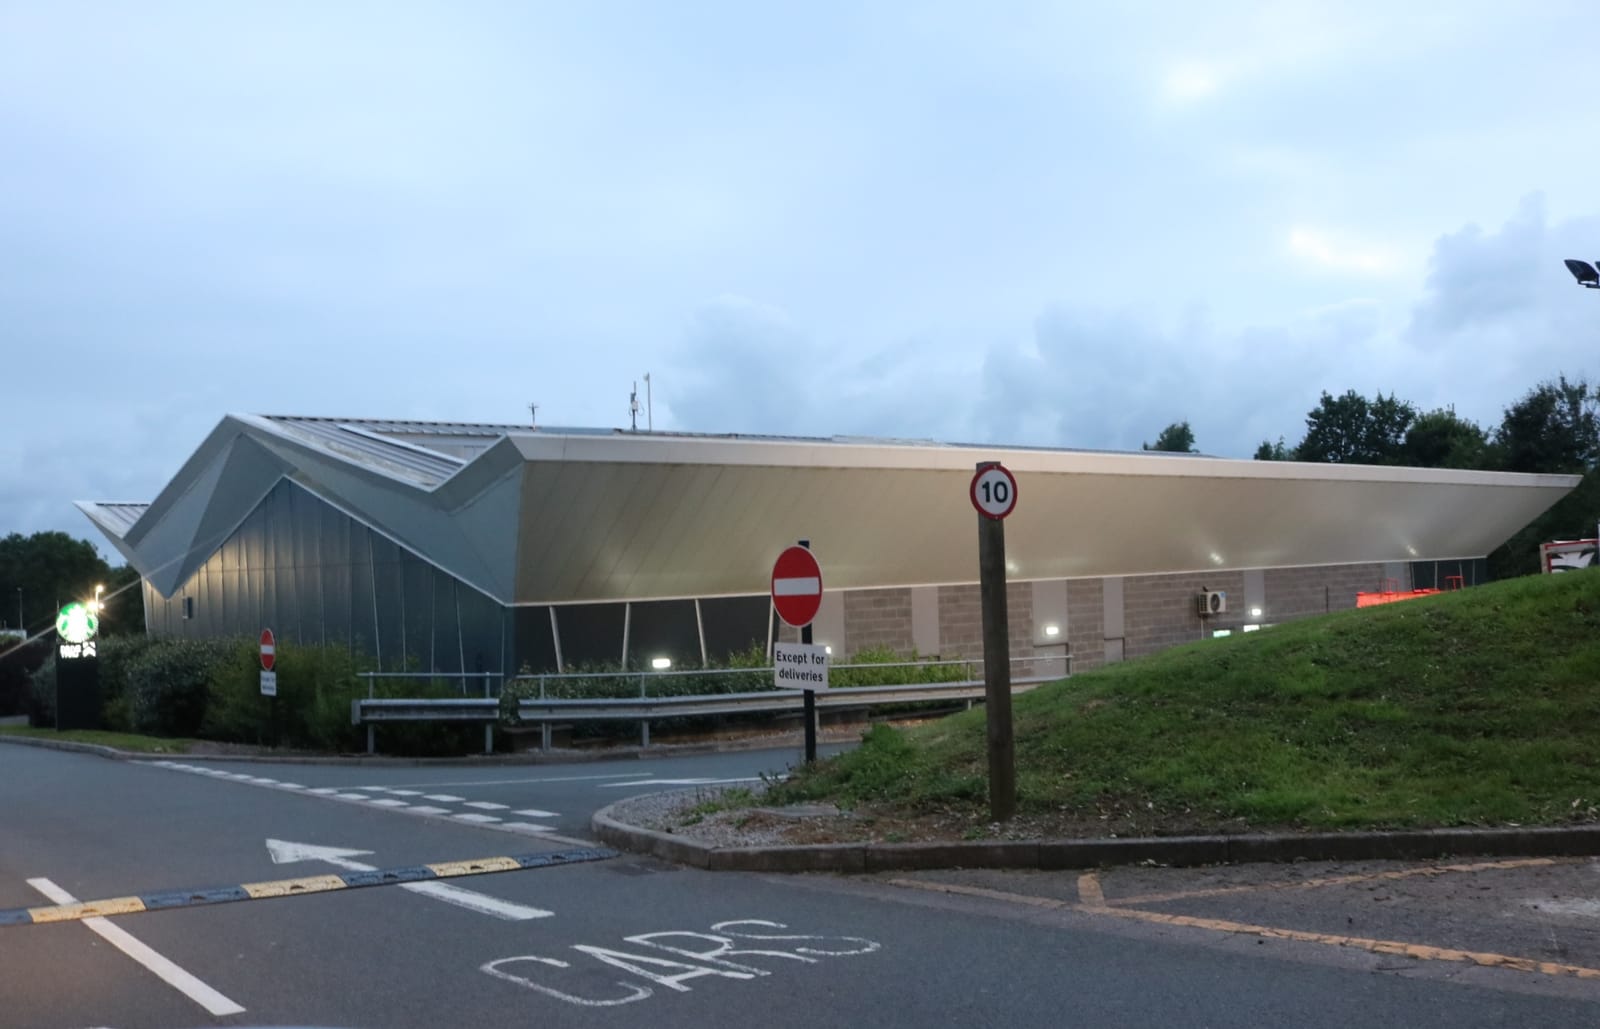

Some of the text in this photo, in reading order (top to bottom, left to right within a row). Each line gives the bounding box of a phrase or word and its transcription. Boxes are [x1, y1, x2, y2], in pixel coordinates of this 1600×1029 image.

[982, 481, 1008, 503] 10
[776, 651, 824, 665] Except for
[779, 668, 823, 682] deliveries
[480, 919, 881, 1006] CARS
